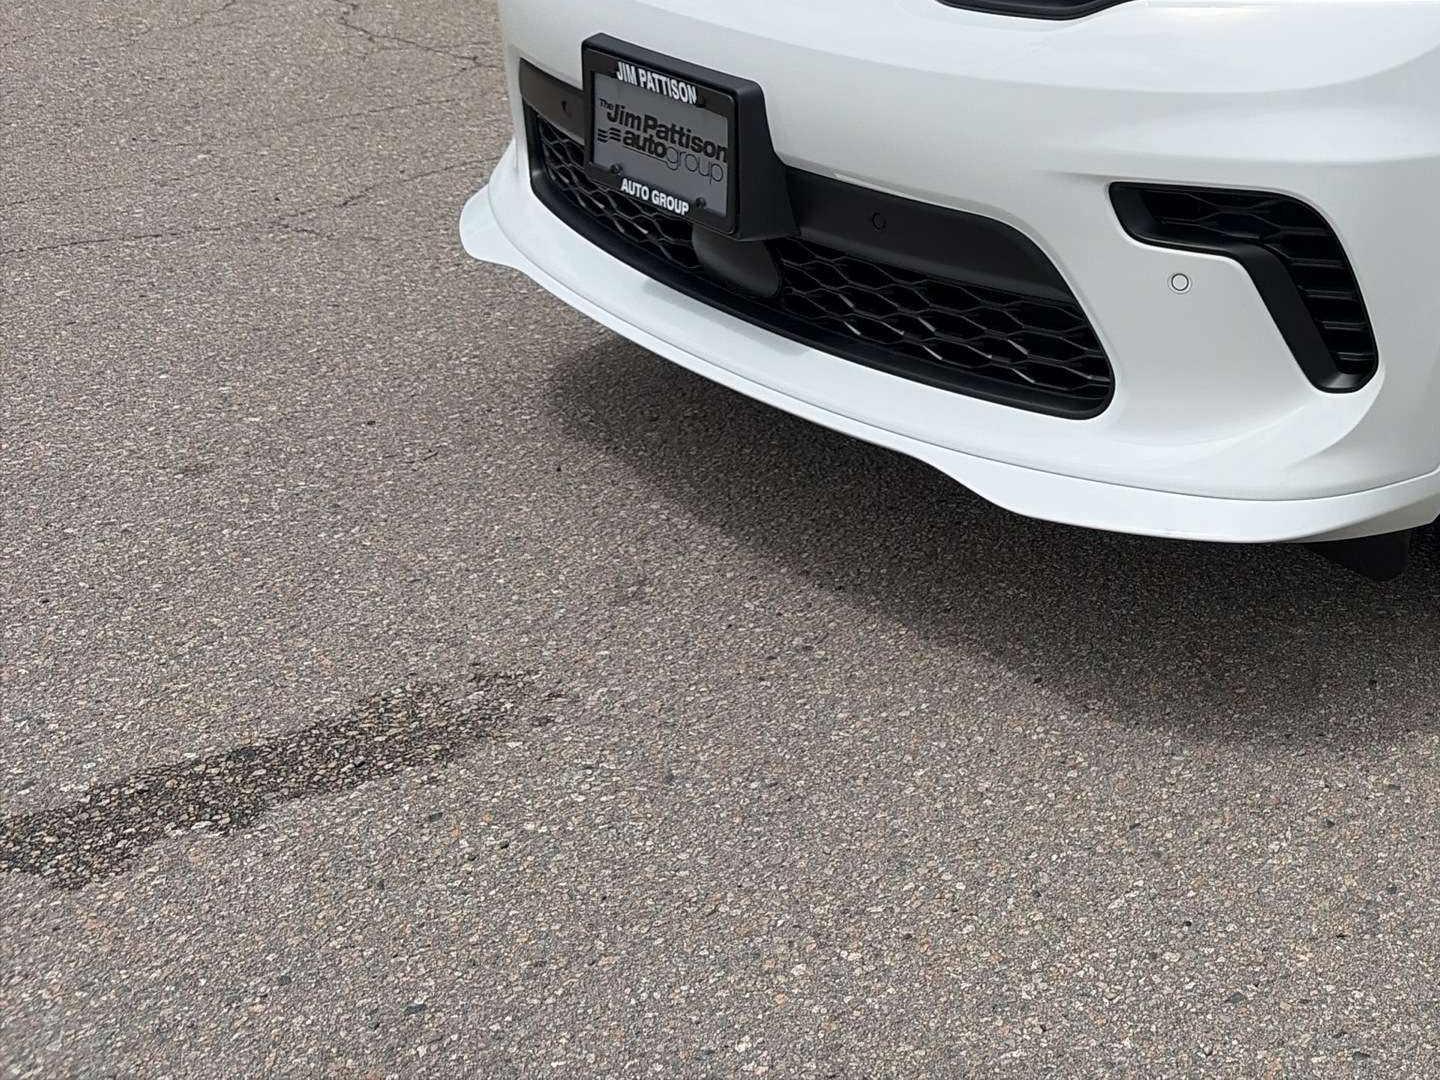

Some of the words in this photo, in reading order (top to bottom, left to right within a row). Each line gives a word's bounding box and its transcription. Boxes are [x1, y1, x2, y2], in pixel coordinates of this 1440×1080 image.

[616, 61, 638, 86] JIM
[638, 68, 698, 104] PATTISON
[600, 98, 614, 111] The
[620, 178, 650, 201] AUTO
[651, 189, 690, 216] GROUP
